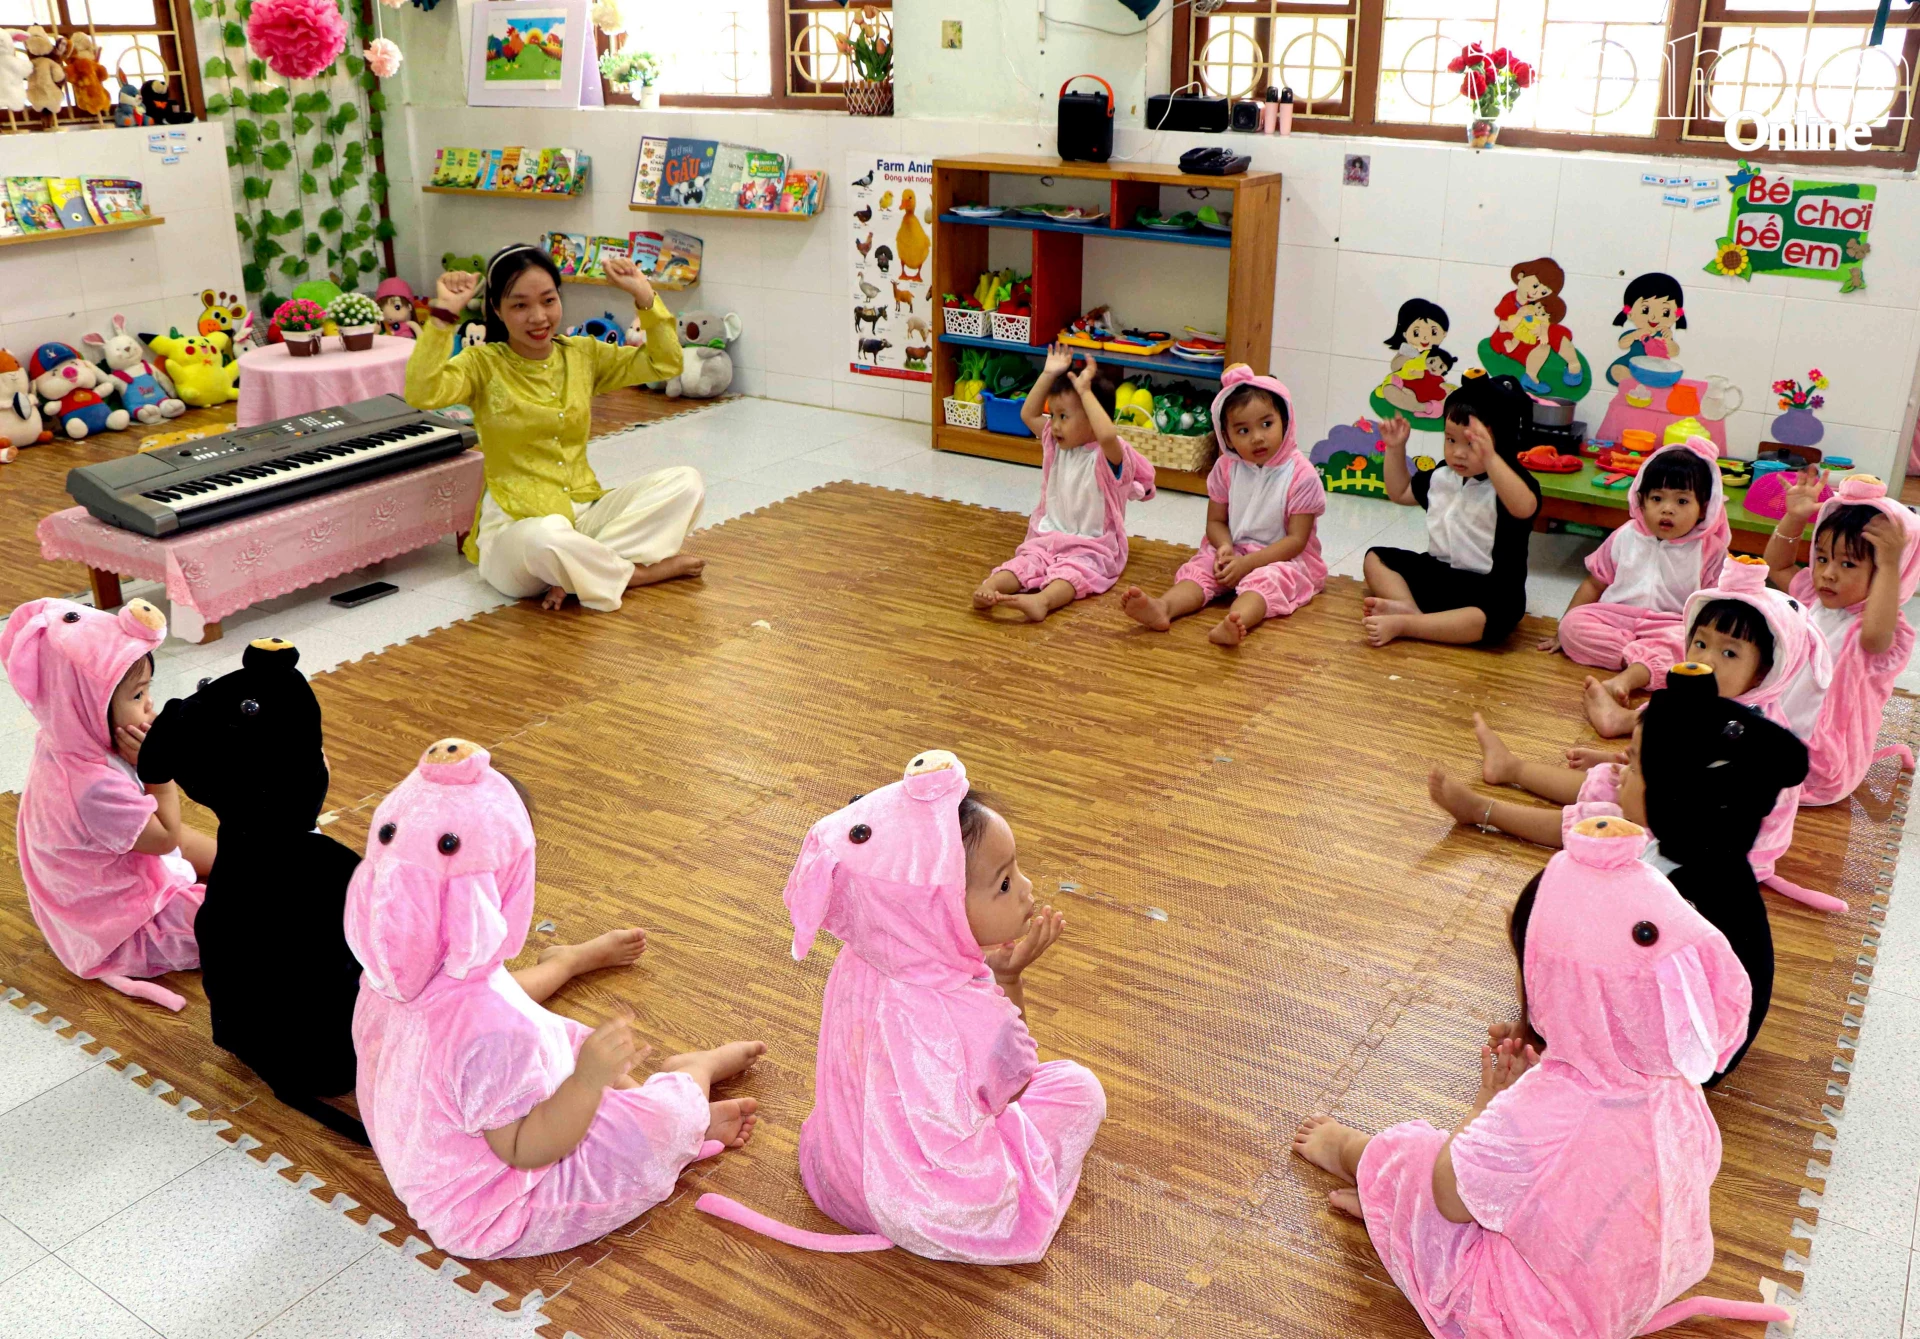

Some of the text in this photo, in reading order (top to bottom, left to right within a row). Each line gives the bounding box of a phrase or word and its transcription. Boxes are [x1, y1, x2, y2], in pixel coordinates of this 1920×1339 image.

[876, 159, 904, 172] Farm
[1748, 176, 1873, 231] Bé chơi
[1736, 215, 1839, 268] bế em
